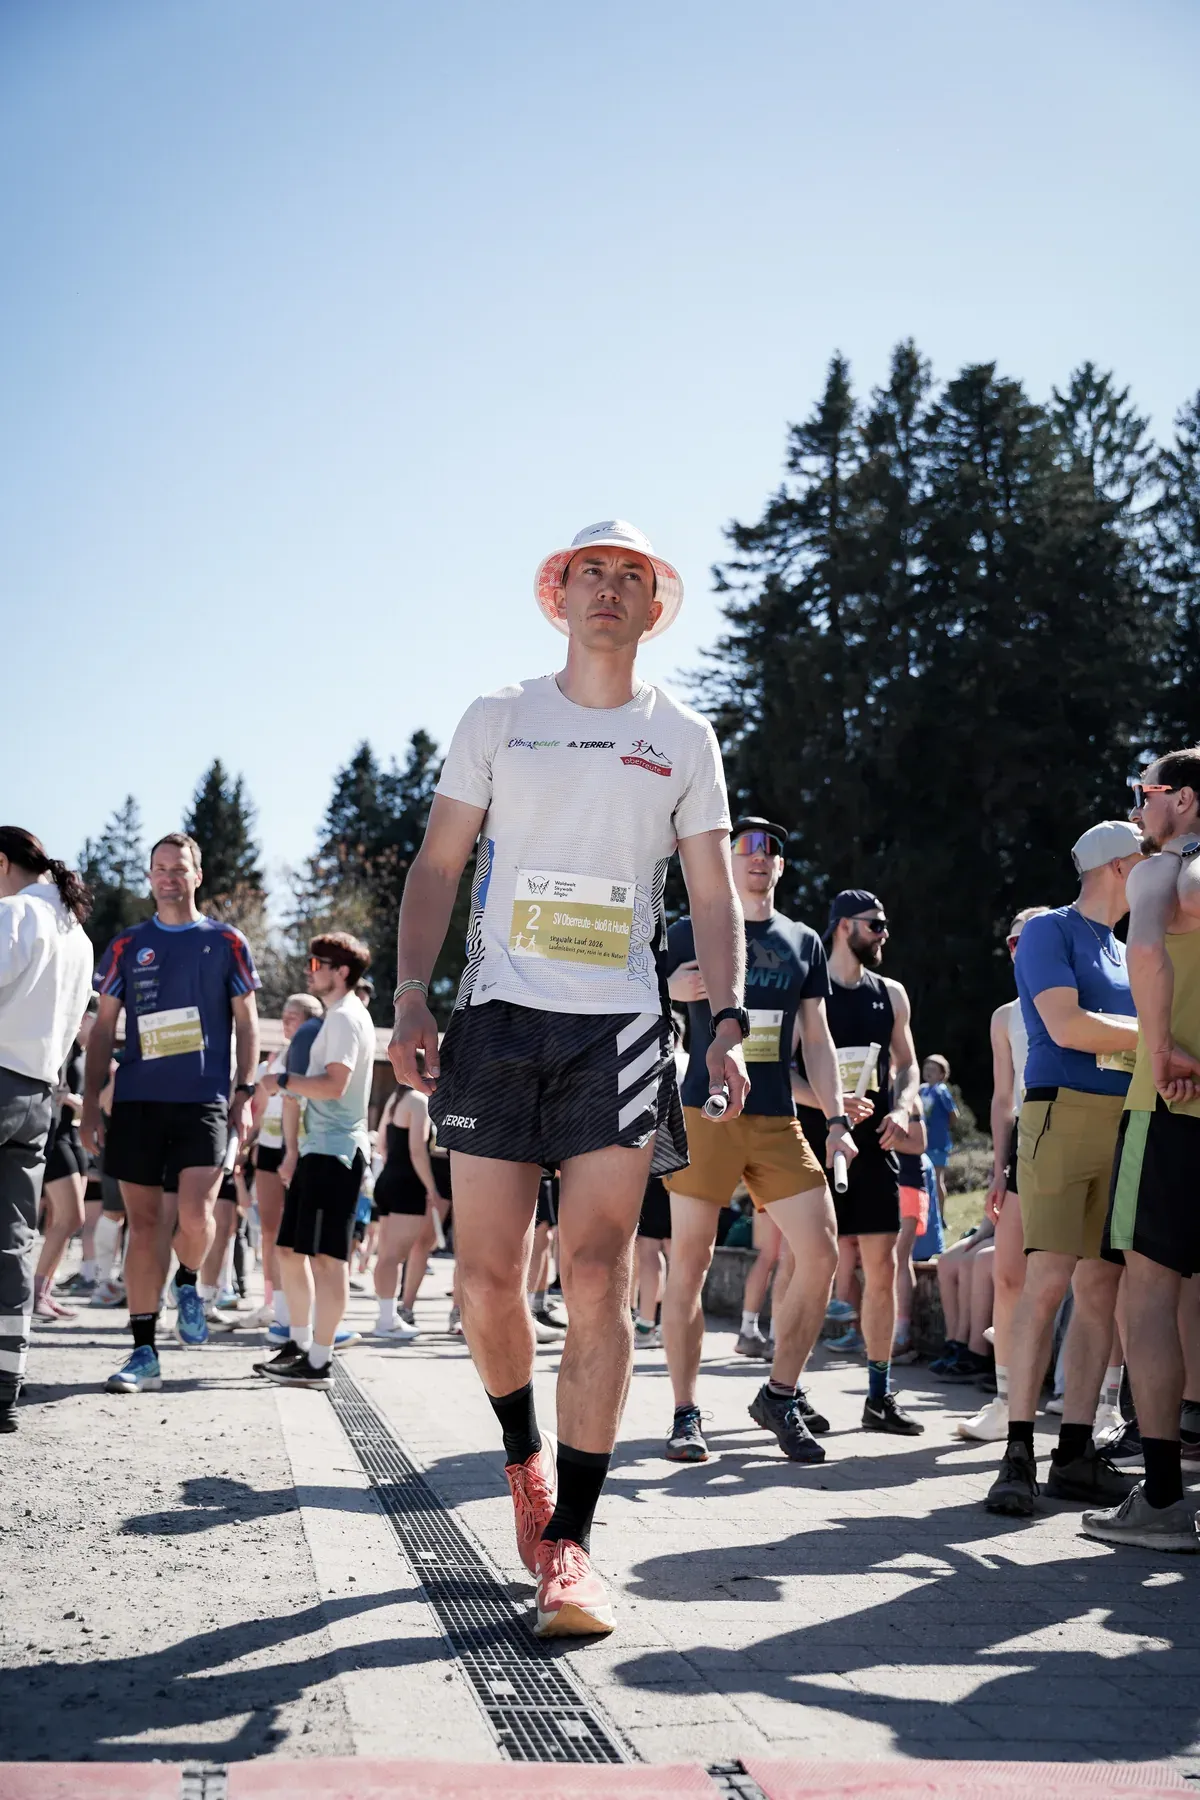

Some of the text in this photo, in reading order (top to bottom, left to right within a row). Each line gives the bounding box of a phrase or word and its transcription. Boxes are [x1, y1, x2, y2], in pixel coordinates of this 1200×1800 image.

[579, 741, 616, 749] TERREX
[624, 757, 662, 774] oberreute
[525, 904, 541, 930] 2
[552, 912, 562, 925] SV
[562, 913, 591, 929] Oberreute
[549, 935, 604, 948] skywalk Lauf 2026
[142, 1031, 159, 1047] 31
[442, 1114, 478, 1129] TERREX
